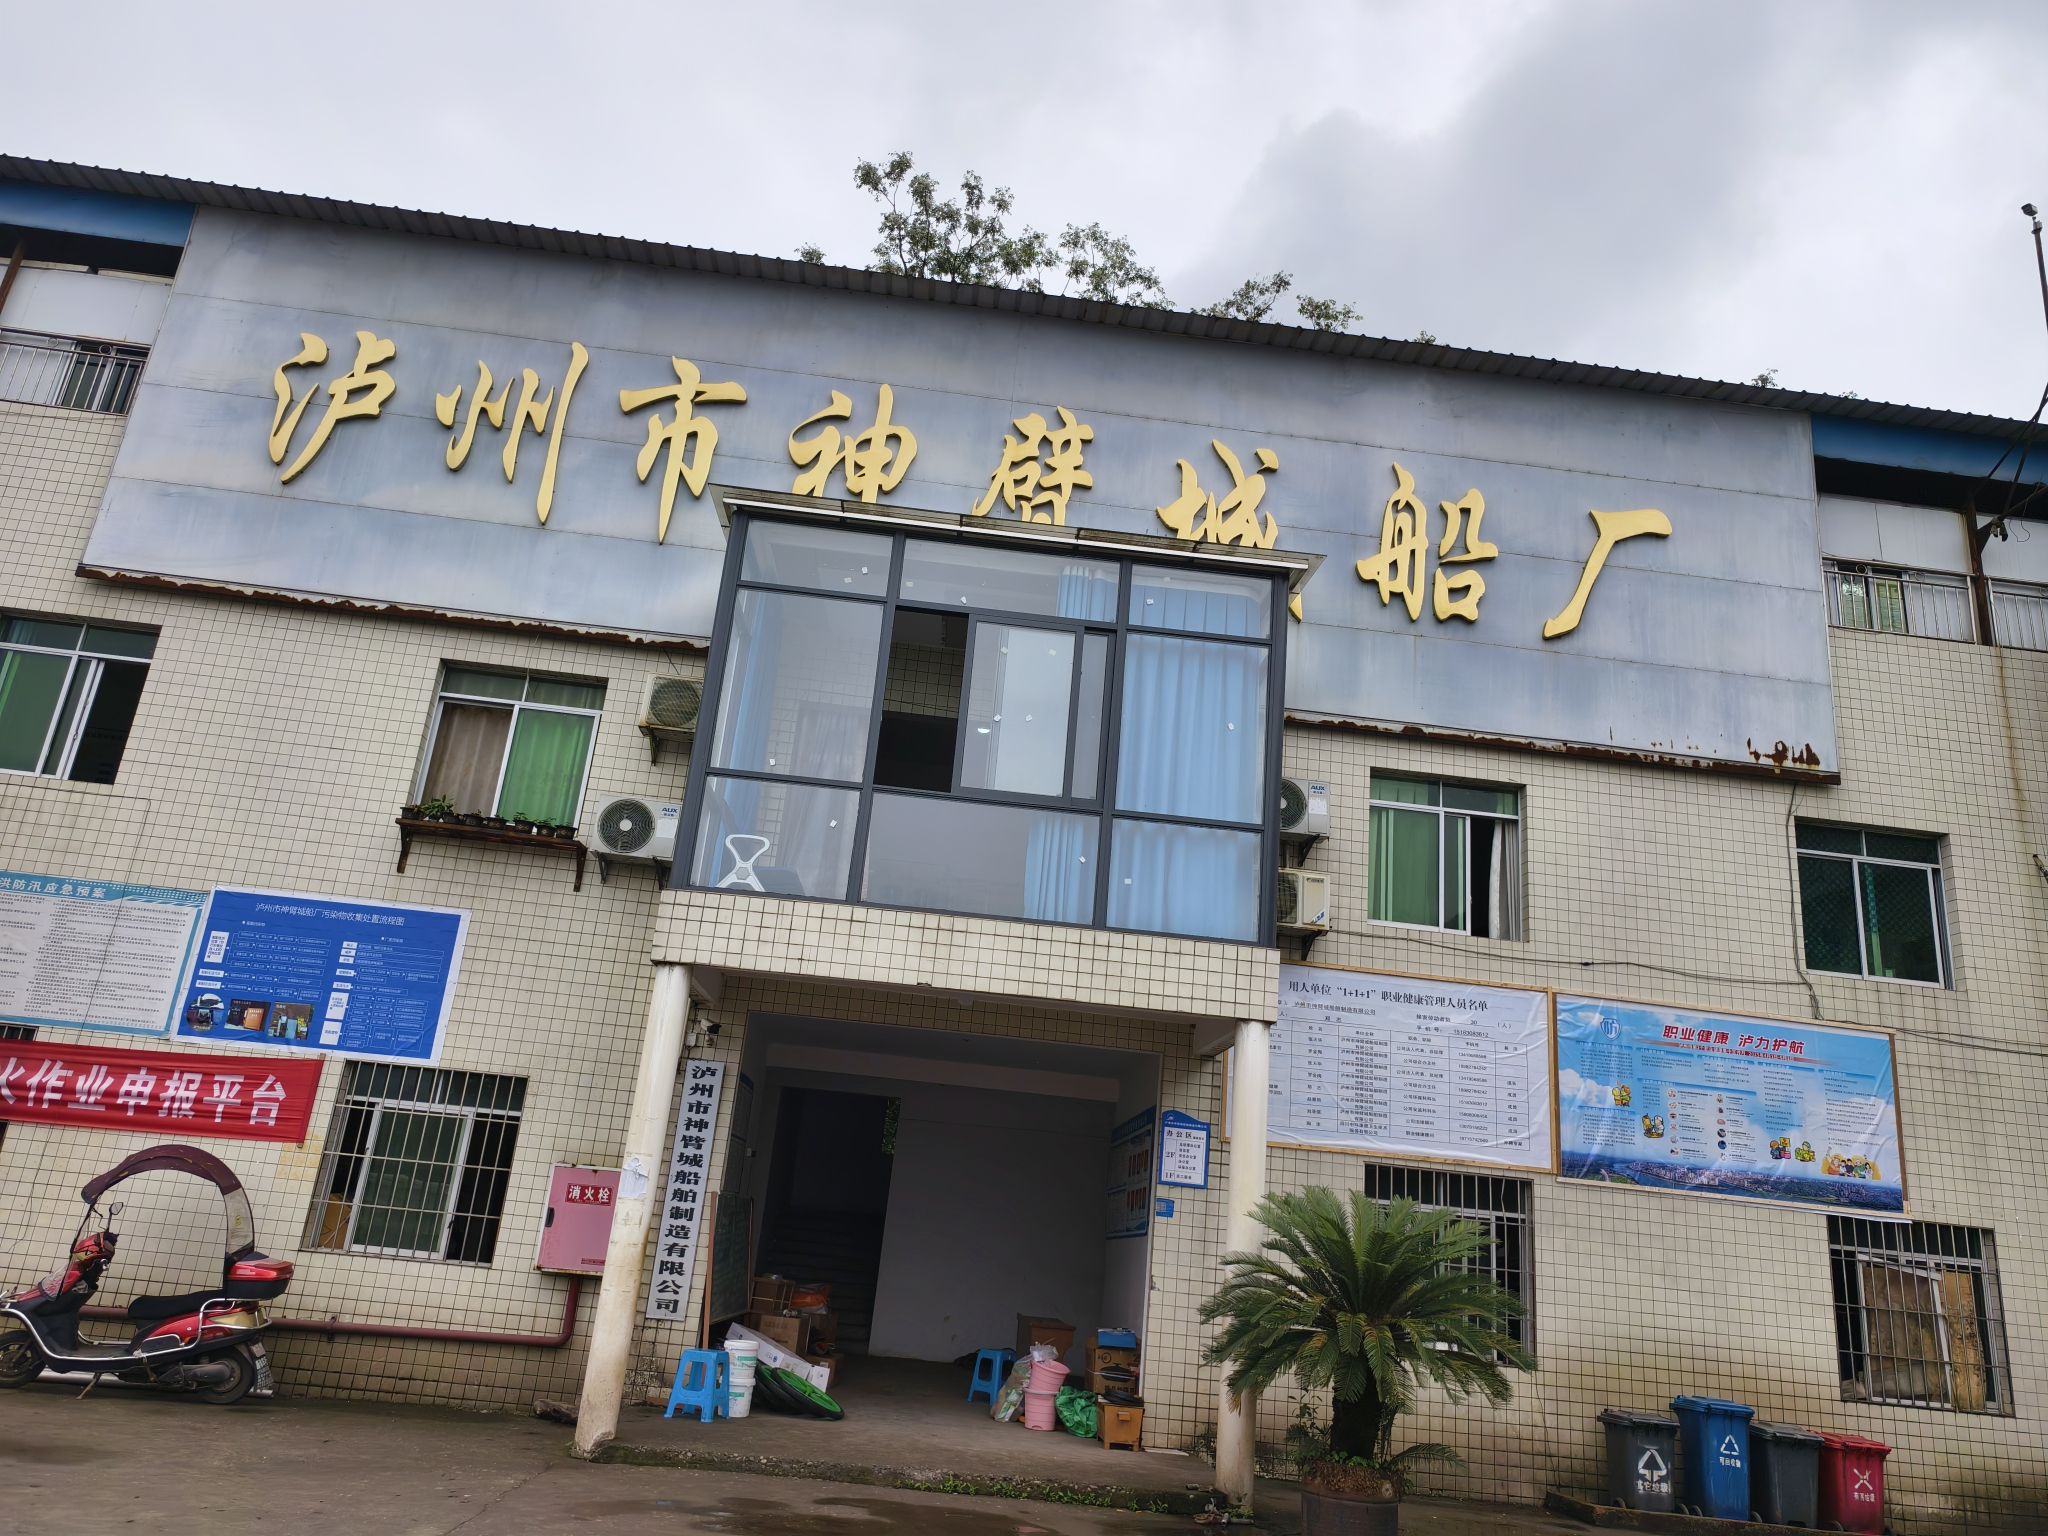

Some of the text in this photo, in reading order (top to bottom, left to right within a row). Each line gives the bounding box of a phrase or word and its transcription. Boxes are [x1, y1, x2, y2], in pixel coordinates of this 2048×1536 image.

[1662, 1024, 1730, 1045] 职业健康
[1738, 1033, 1805, 1055] 泸力护航
[568, 1185, 610, 1203] 消火栓
[655, 1065, 719, 1315] 泸州市神臂城船舶制造有限公司
